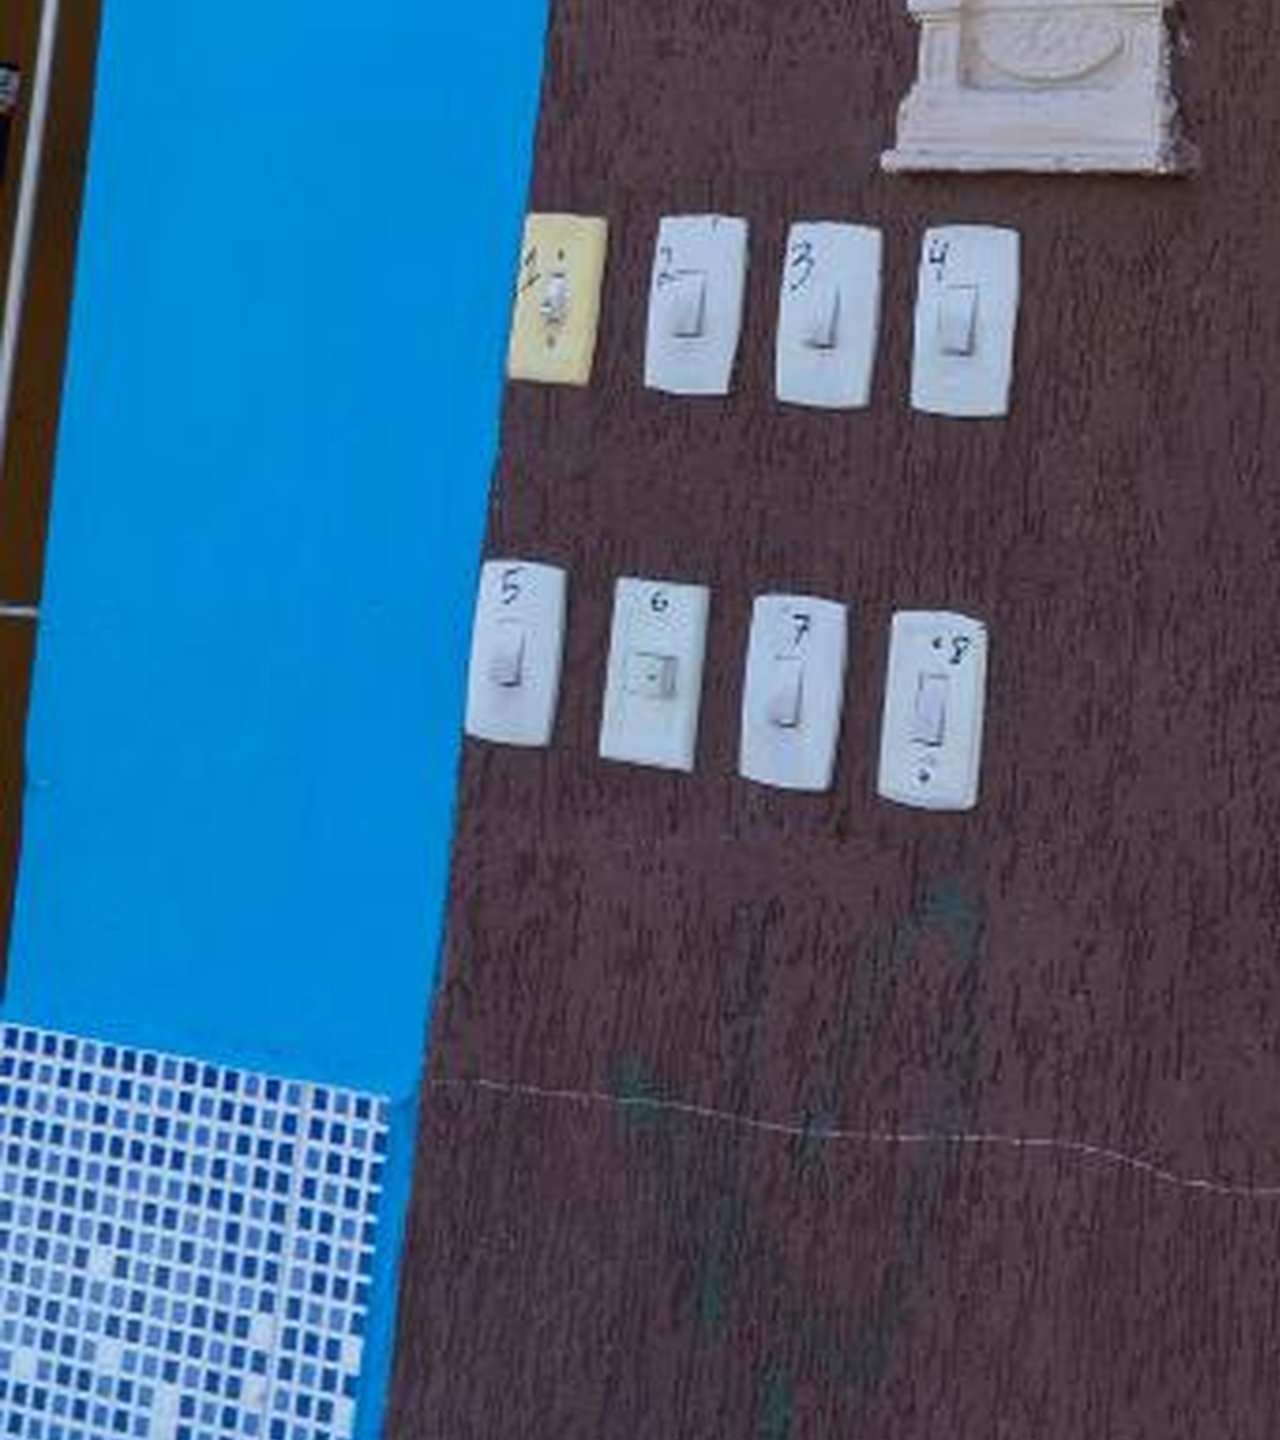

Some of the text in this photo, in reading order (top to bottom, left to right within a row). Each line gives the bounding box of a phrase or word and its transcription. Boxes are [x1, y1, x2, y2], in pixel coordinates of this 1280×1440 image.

[501, 566, 525, 605] 5
[650, 591, 669, 612] 6
[792, 614, 810, 646] 7
